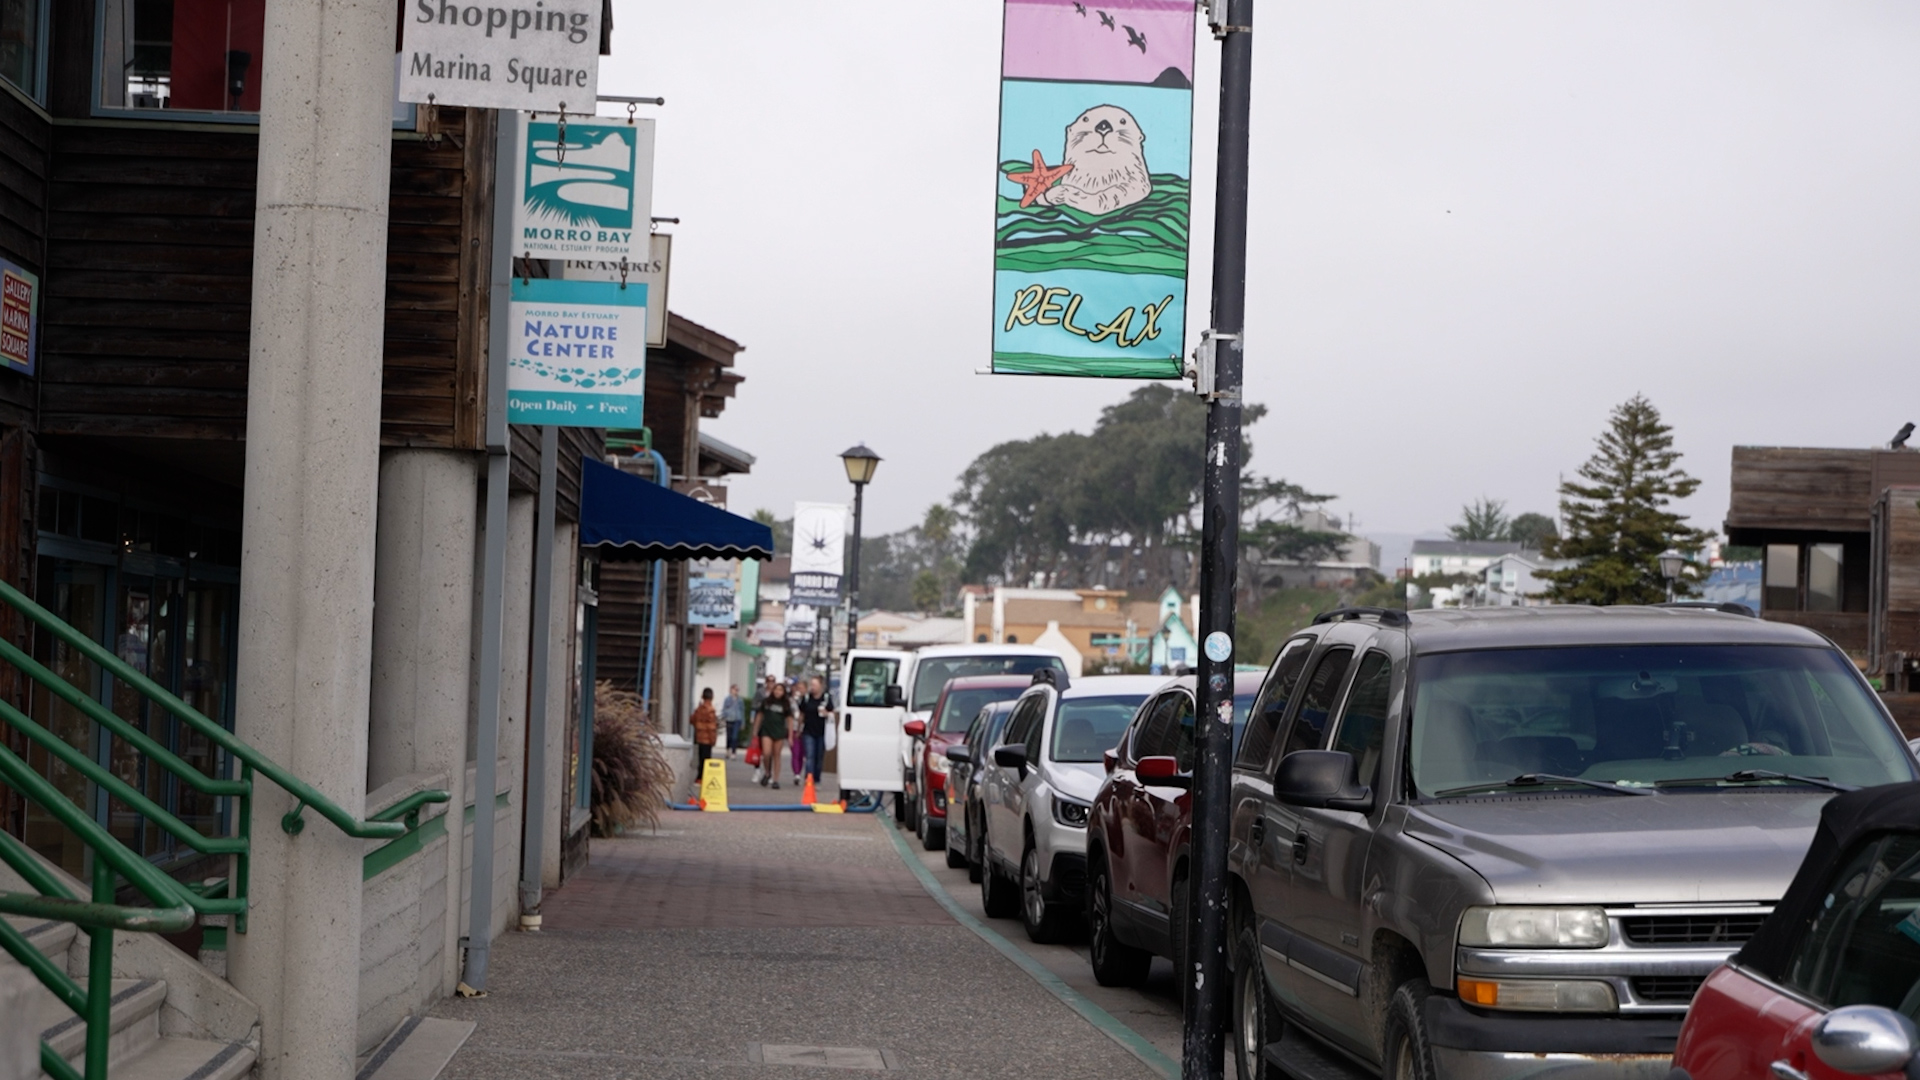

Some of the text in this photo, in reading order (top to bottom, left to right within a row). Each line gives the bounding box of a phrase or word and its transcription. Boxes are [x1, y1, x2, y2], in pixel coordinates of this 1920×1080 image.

[416, 0, 589, 44] Shopping
[410, 52, 588, 93] Marina Square
[523, 227, 632, 244] MORRO BAY
[523, 243, 630, 254] NATIONAL ESTUARY PROGRAM
[5, 276, 32, 303] GALLERY
[4, 307, 29, 333] MARINA
[525, 309, 559, 318] MORRO
[582, 312, 620, 320] ESTUARY
[1004, 283, 1174, 349] RELAX
[524, 320, 618, 341] NATURE
[2, 333, 28, 358] SQUARE
[526, 339, 615, 359] CENTER
[509, 398, 628, 414] Open Daily Free
